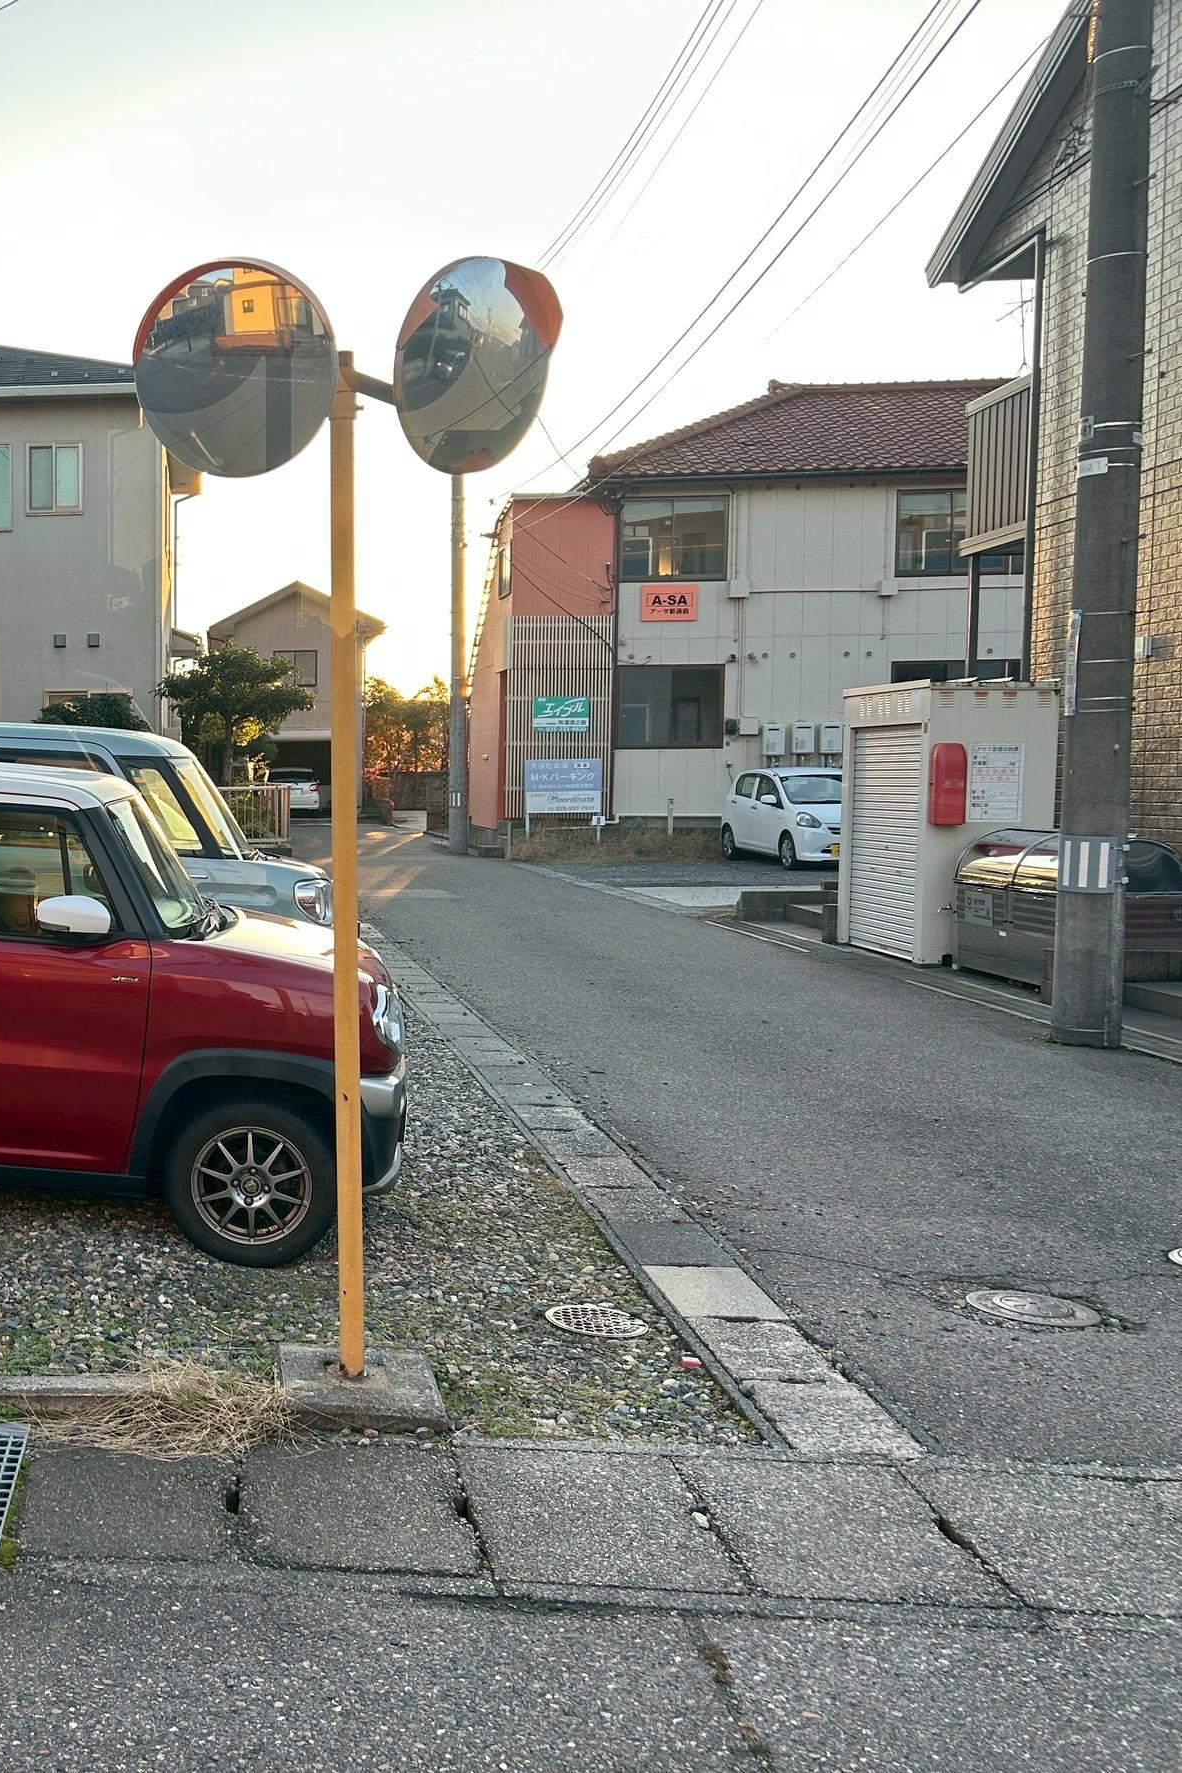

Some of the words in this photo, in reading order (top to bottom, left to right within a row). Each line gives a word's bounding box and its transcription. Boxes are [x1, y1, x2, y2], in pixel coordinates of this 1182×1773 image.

[651, 594, 688, 606] A-SA
[538, 698, 586, 718] エイブル
[547, 793, 595, 804] Coordinate
